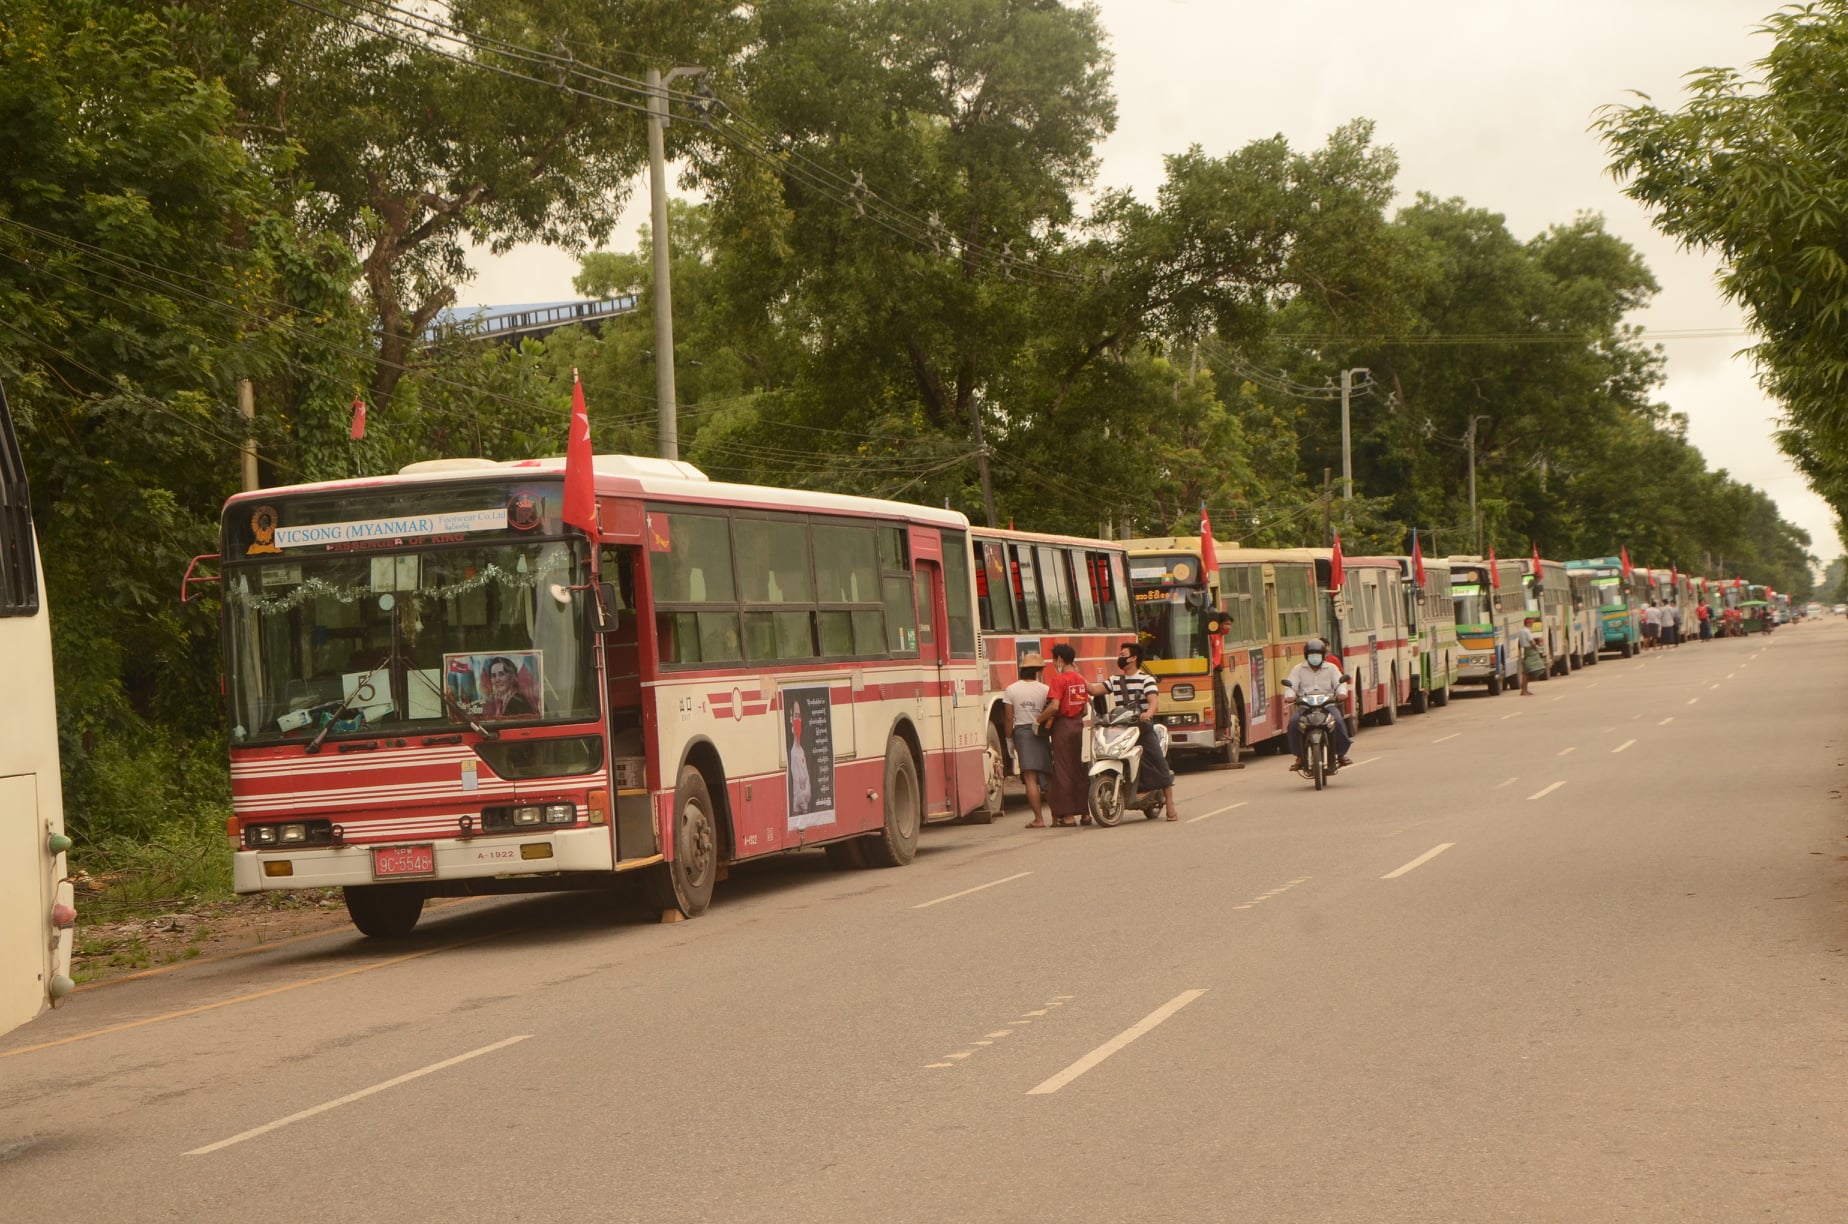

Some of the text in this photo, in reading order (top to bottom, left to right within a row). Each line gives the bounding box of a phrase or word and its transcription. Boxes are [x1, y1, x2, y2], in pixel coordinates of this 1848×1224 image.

[276, 526, 342, 544] VICSONG
[345, 518, 434, 541] (MYANMAR)
[326, 532, 465, 551] PASSENGER OF KING
[357, 670, 376, 702] 5
[380, 856, 429, 873] 9C-5548
[477, 850, 515, 860] A-1922
